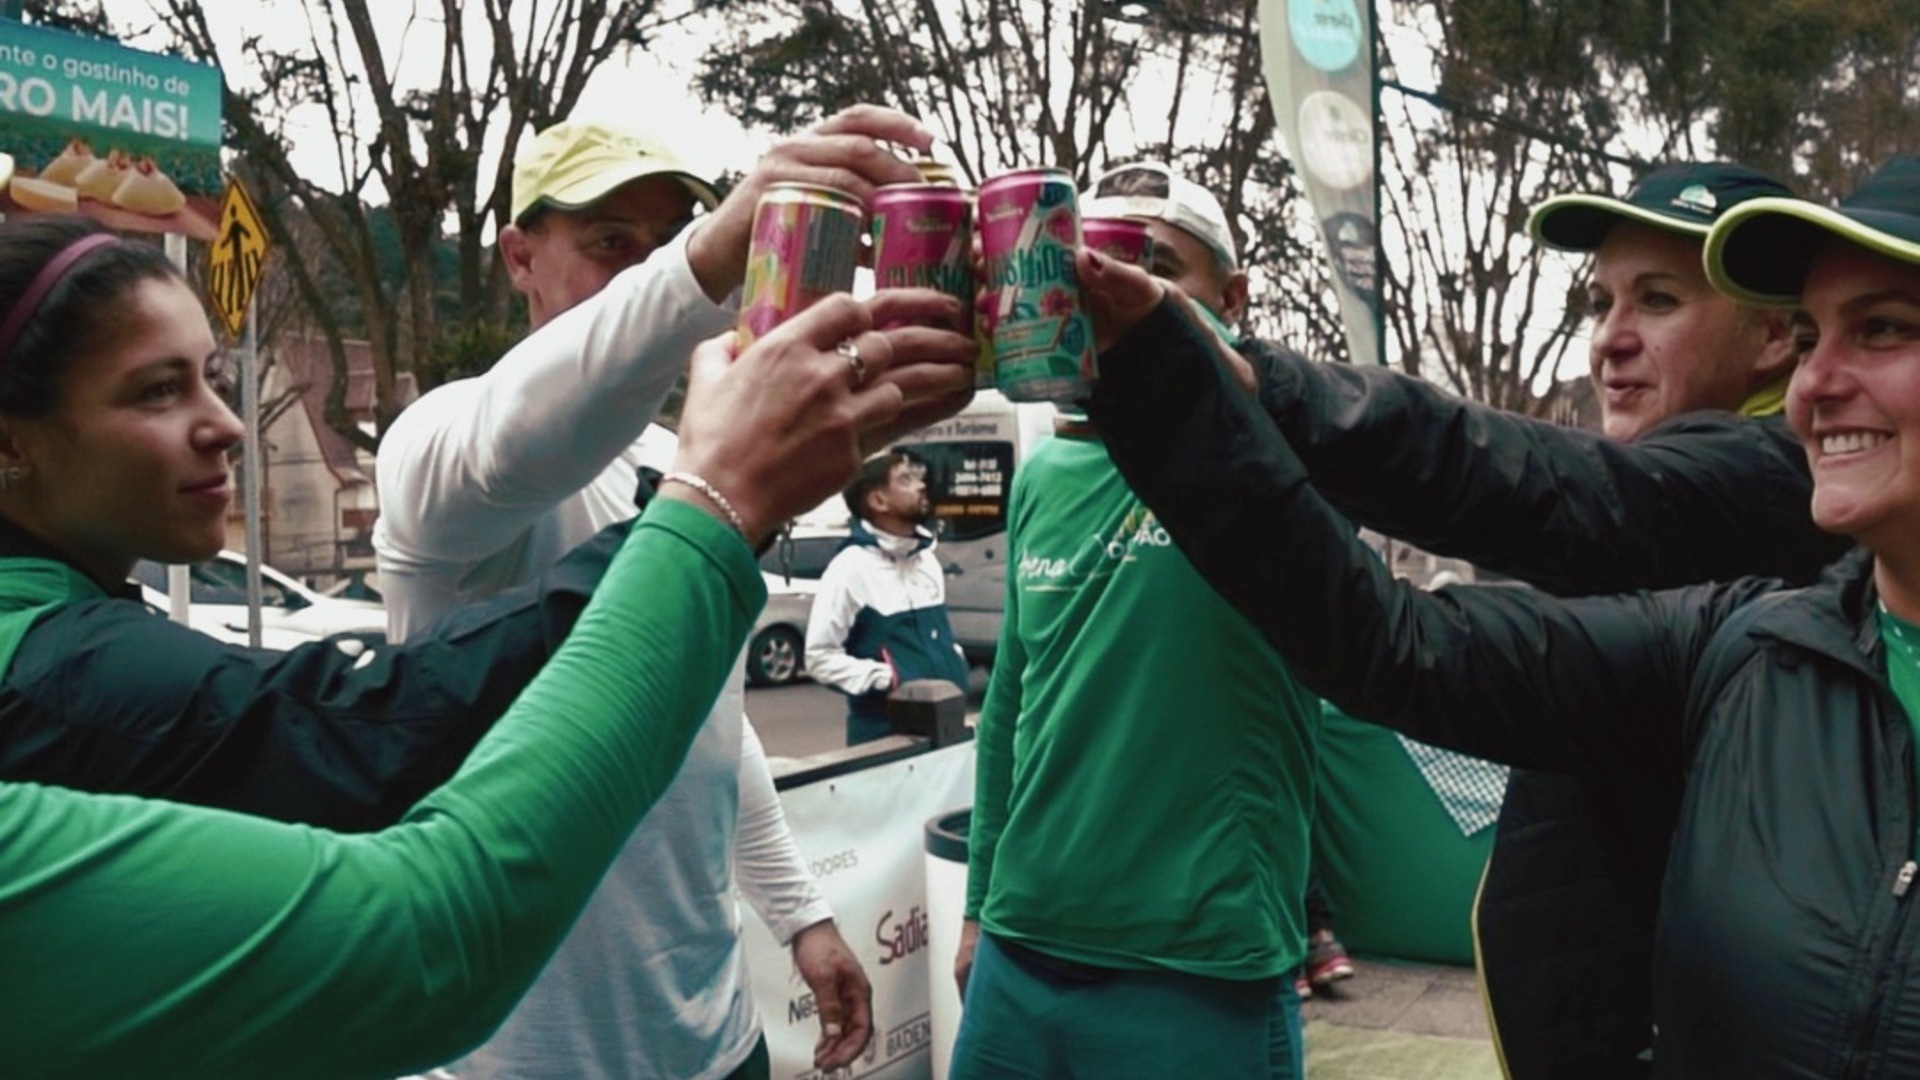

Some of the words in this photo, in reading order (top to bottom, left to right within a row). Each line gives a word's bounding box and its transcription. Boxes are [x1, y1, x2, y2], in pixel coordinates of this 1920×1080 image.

[42, 53, 58, 71] o
[63, 58, 159, 90] gostinho
[164, 76, 190, 97] de
[71, 84, 189, 140] MAIS!
[807, 847, 859, 878] DORES
